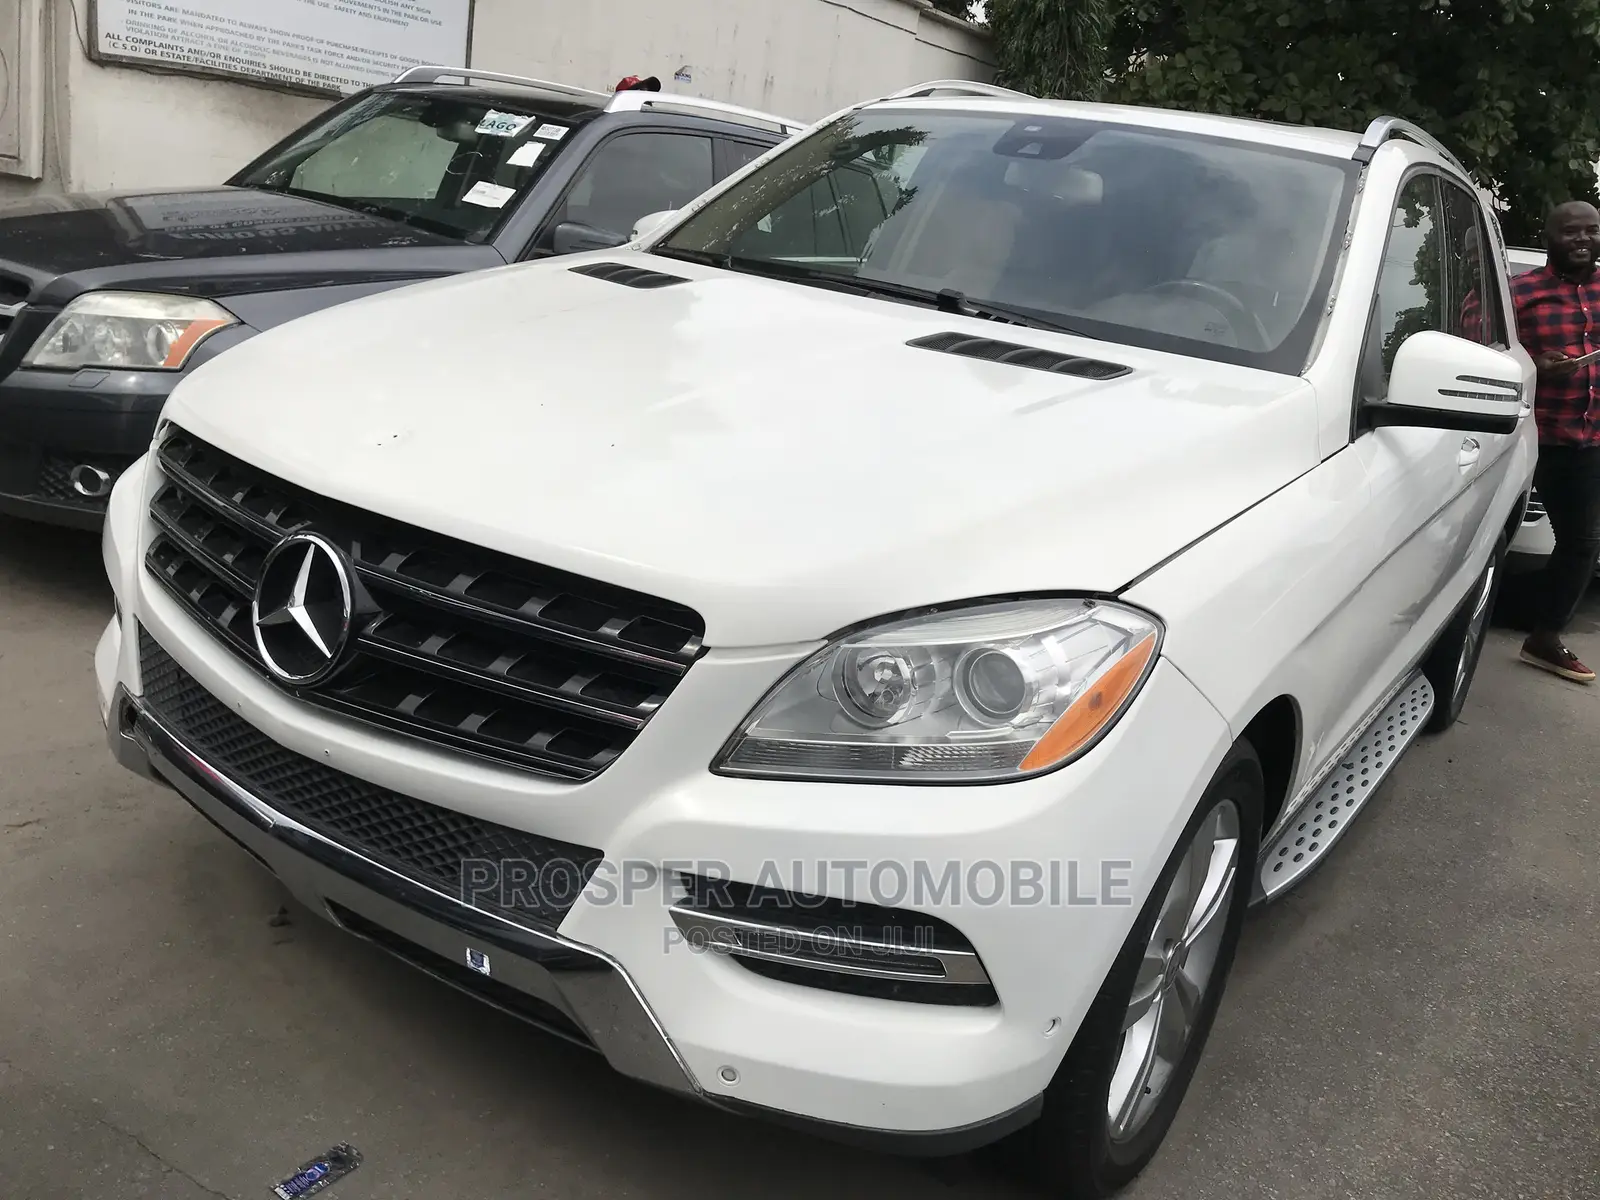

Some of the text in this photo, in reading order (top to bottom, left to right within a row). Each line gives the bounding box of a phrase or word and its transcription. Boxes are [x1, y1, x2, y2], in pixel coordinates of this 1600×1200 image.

[128, 8, 137, 16] IN
[139, 10, 155, 19] THE
[156, 14, 178, 24] PARK
[391, 8, 403, 18] THE
[104, 32, 123, 41] ALL
[125, 35, 185, 53] COMPLAINTS
[187, 47, 222, 60] AND/OR
[223, 54, 267, 69] ENQUIRIES
[269, 64, 301, 76] SHOULD
[302, 70, 313, 78] BE
[314, 73, 349, 85] DIRECTED
[350, 79, 361, 87] TO
[144, 47, 158, 56] OR
[160, 50, 238, 71] ESTATE/FACILITIES
[240, 66, 292, 82] DEPARTMENT
[322, 82, 342, 90] PARK
